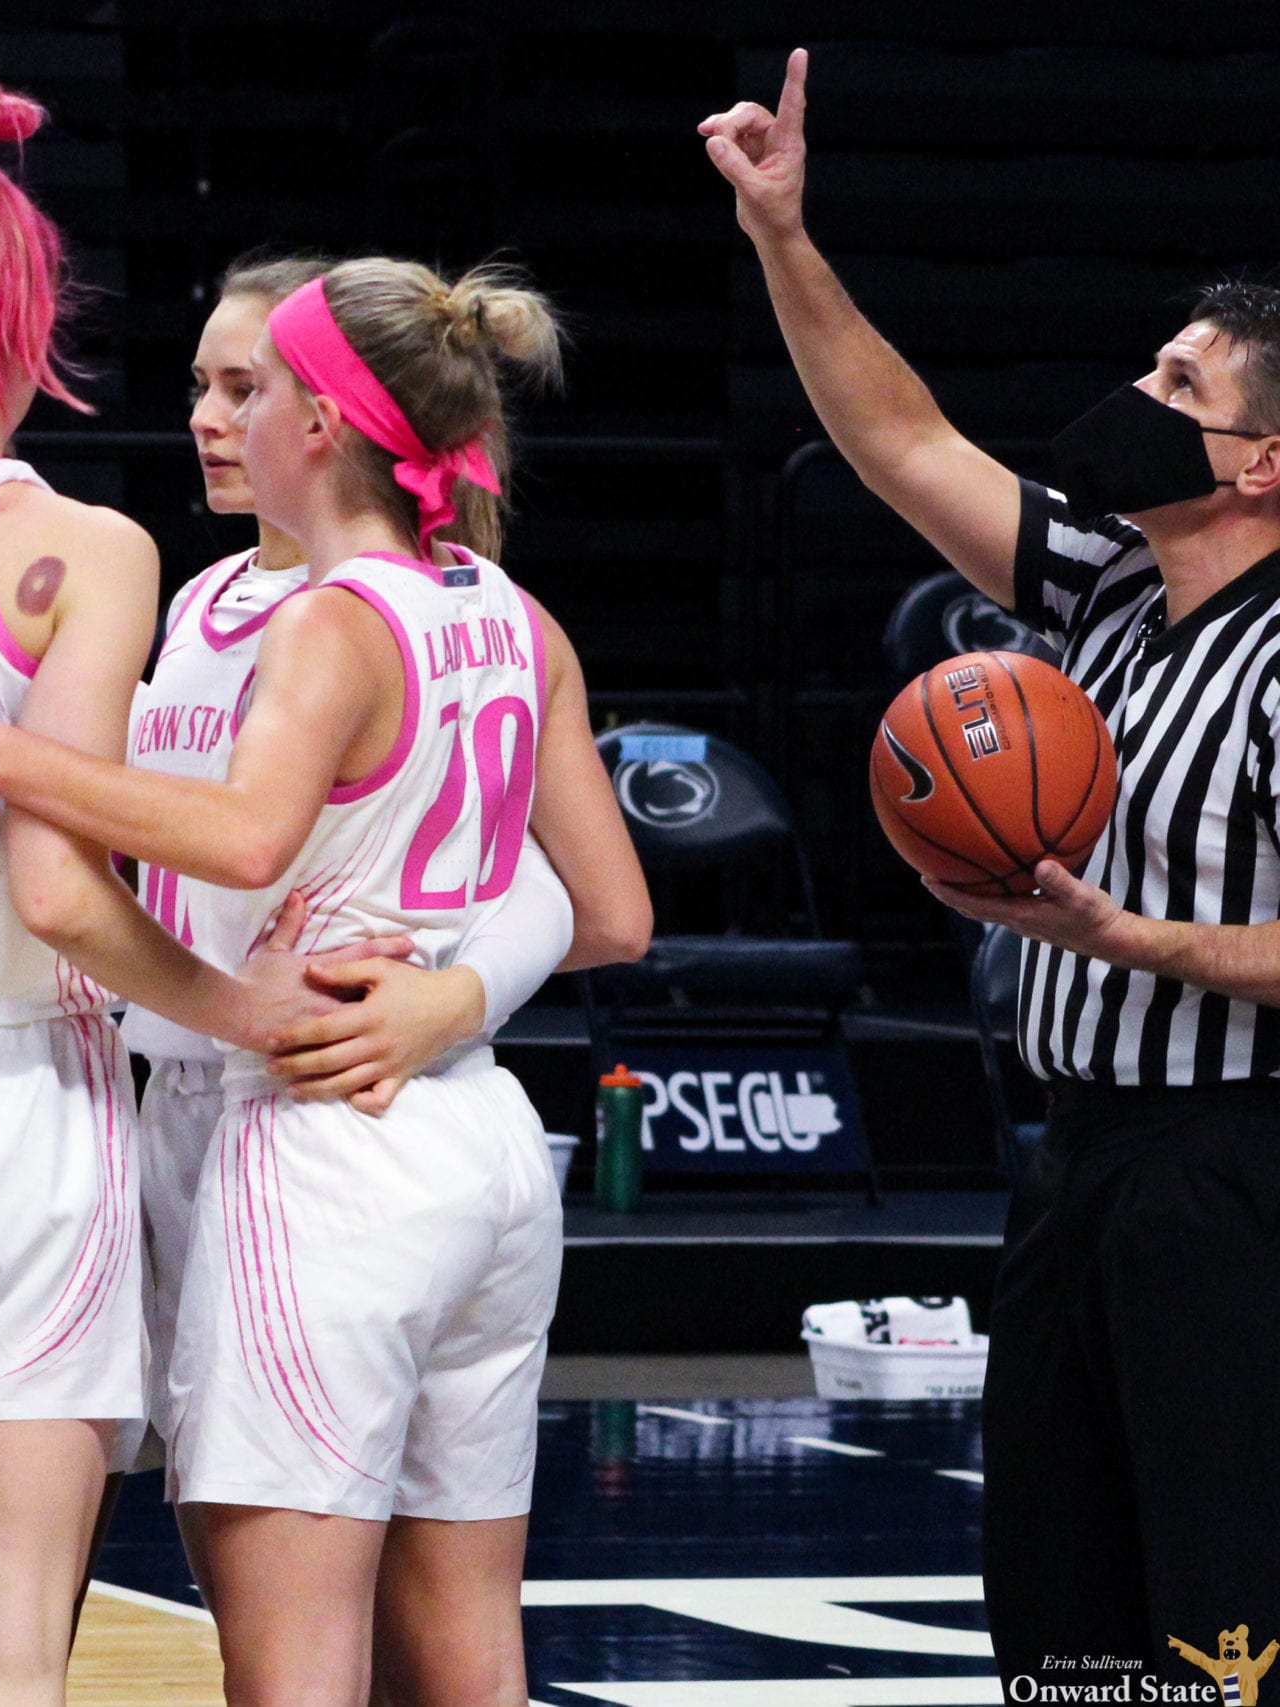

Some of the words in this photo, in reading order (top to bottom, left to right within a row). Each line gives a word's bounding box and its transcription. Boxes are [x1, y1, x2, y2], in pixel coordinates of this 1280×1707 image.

[131, 705, 186, 756] ENN
[183, 705, 230, 753] STA
[944, 666, 1001, 761] ELITE
[400, 695, 533, 911] 20
[628, 1071, 819, 1152] PSECU
